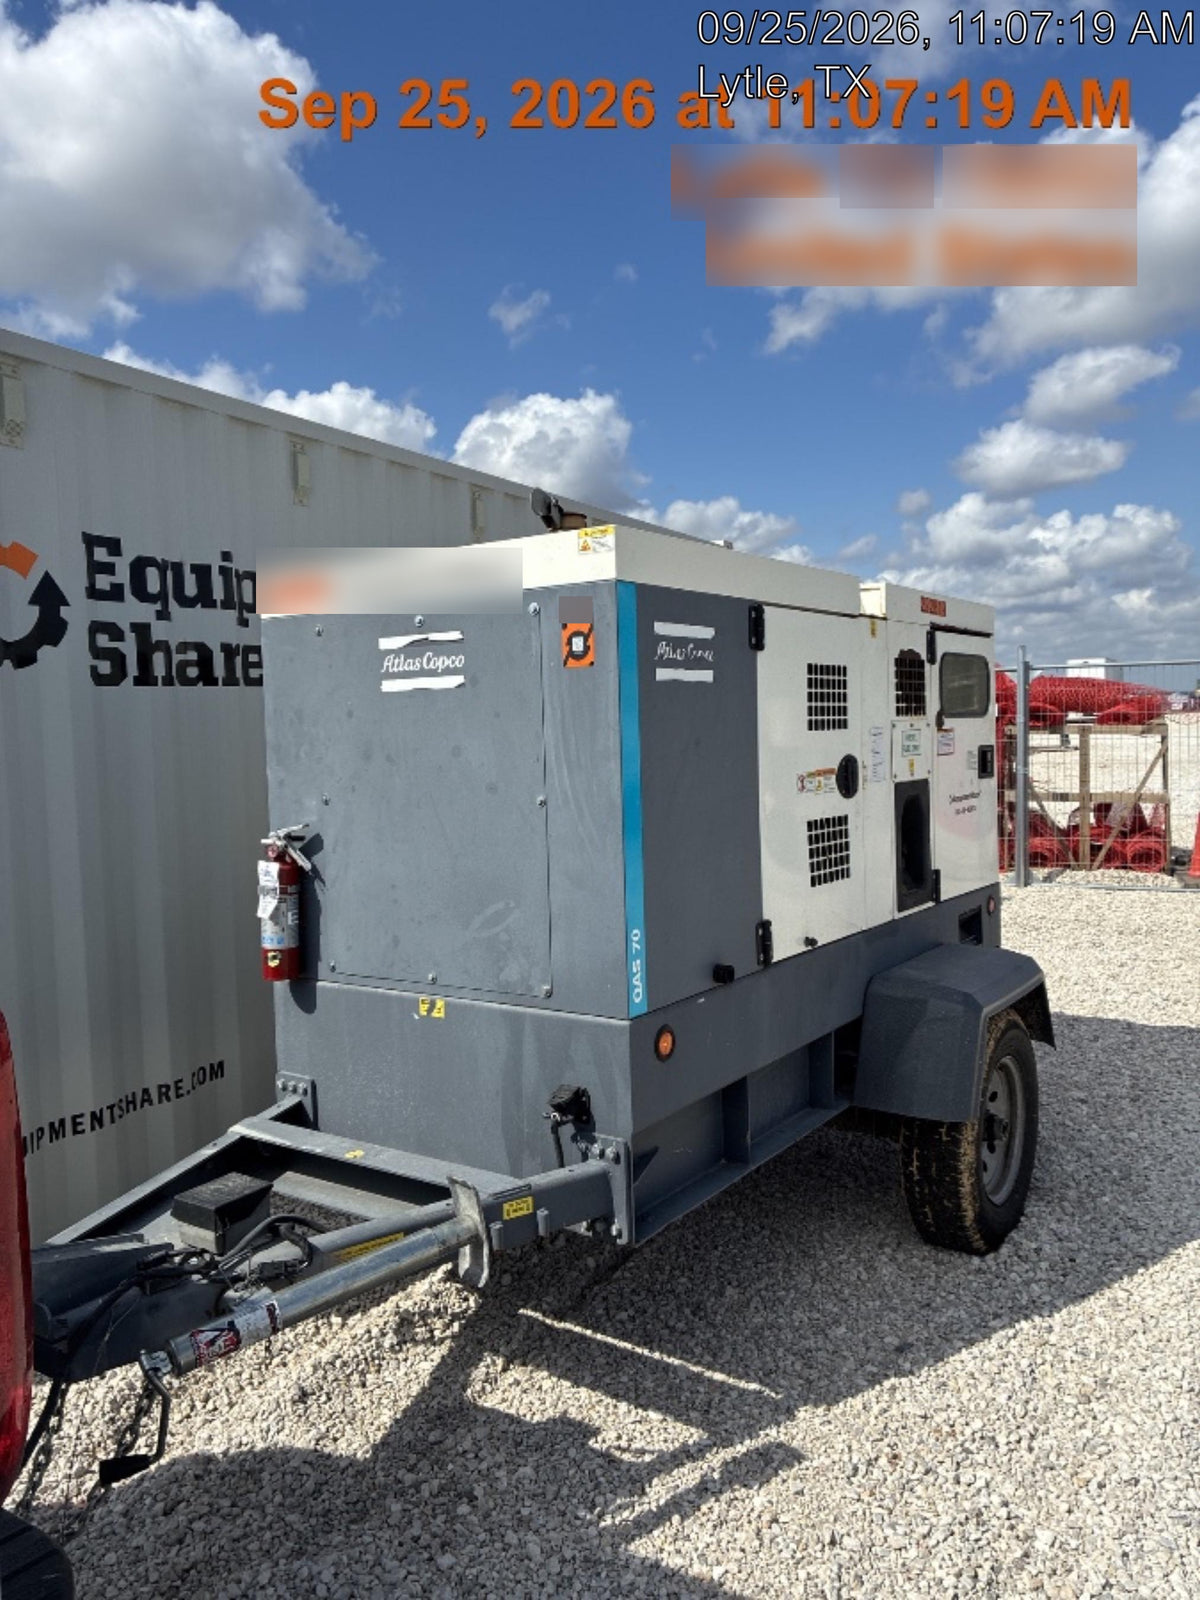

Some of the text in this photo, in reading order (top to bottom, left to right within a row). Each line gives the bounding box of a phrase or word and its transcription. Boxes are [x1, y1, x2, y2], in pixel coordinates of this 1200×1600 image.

[88, 620, 264, 687] Share
[381, 651, 465, 673] Atlas Copco
[631, 929, 642, 1003] QAS 70
